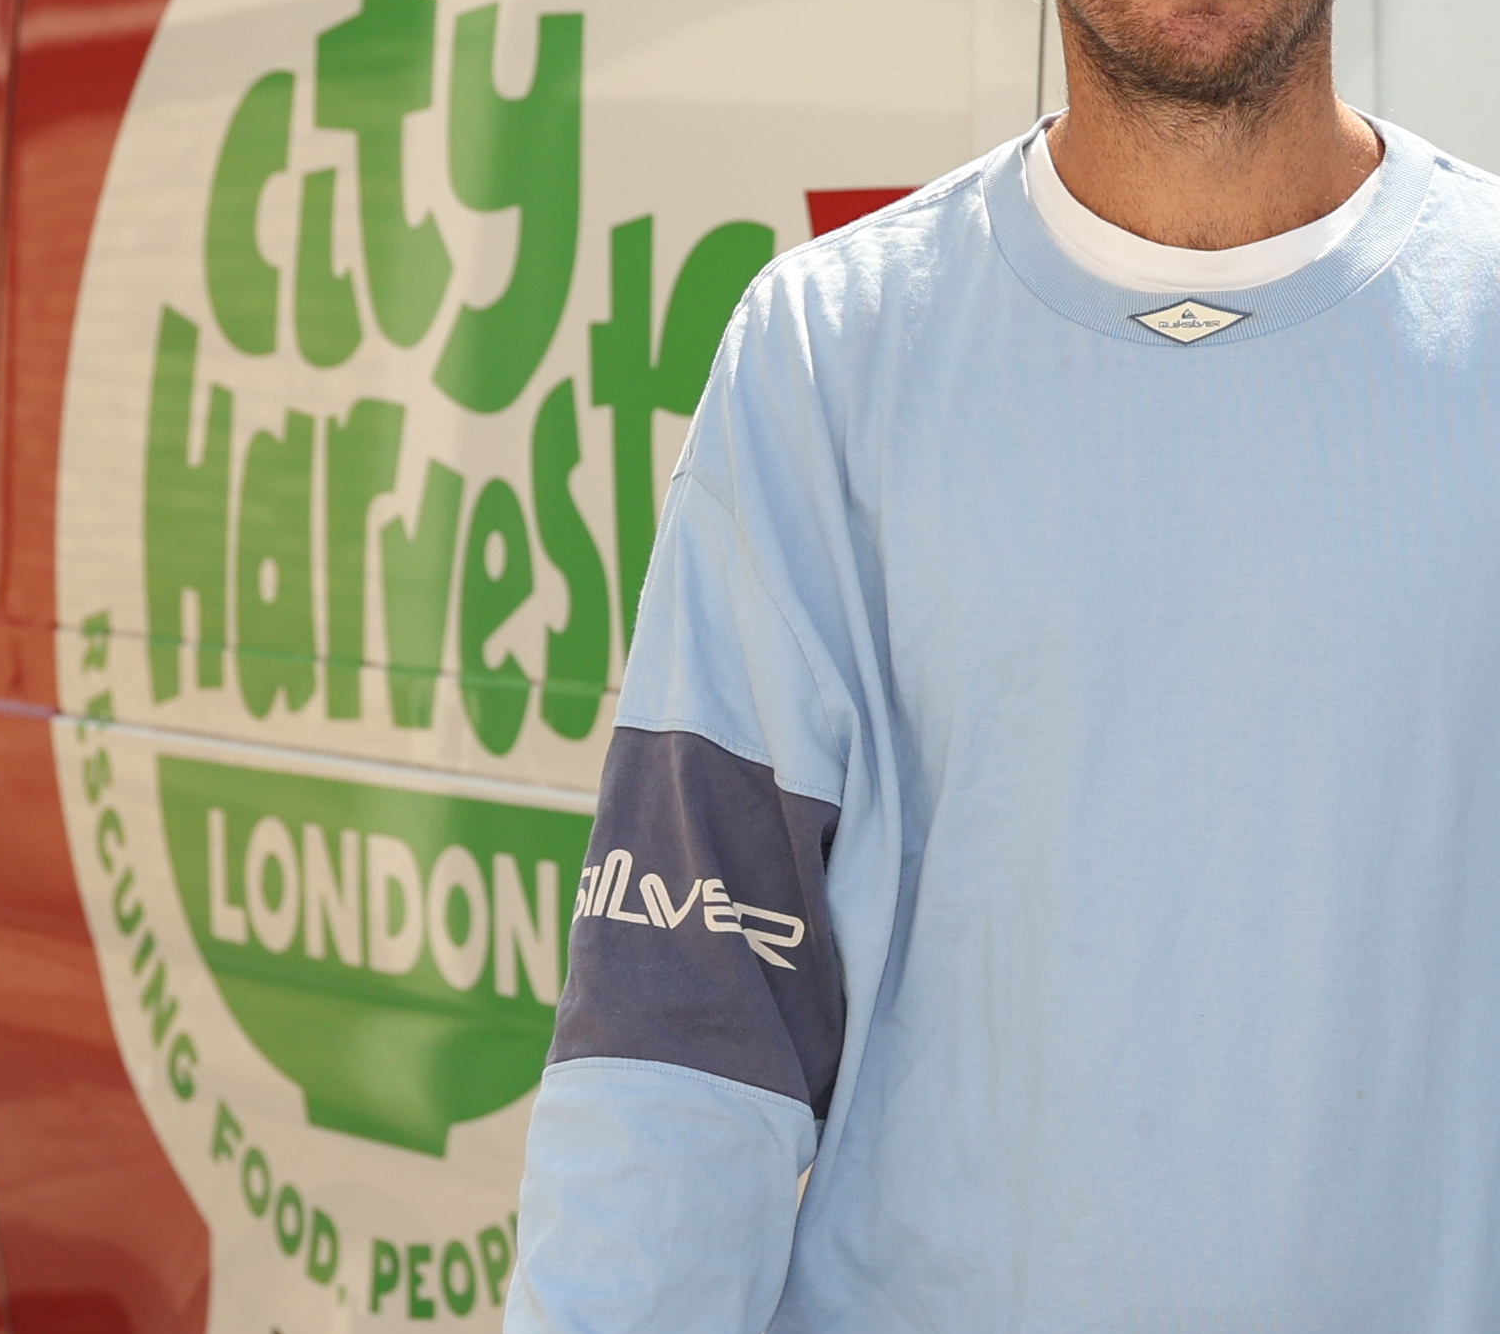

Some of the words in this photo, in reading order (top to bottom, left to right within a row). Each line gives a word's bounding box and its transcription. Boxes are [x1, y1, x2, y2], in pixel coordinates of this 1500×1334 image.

[76, 610, 199, 1102] RESCUING
[211, 1097, 346, 1306] FOOD,
[369, 1212, 518, 1322] PEOP
[206, 806, 560, 1007] LONDON
[571, 848, 805, 971] SILVER
